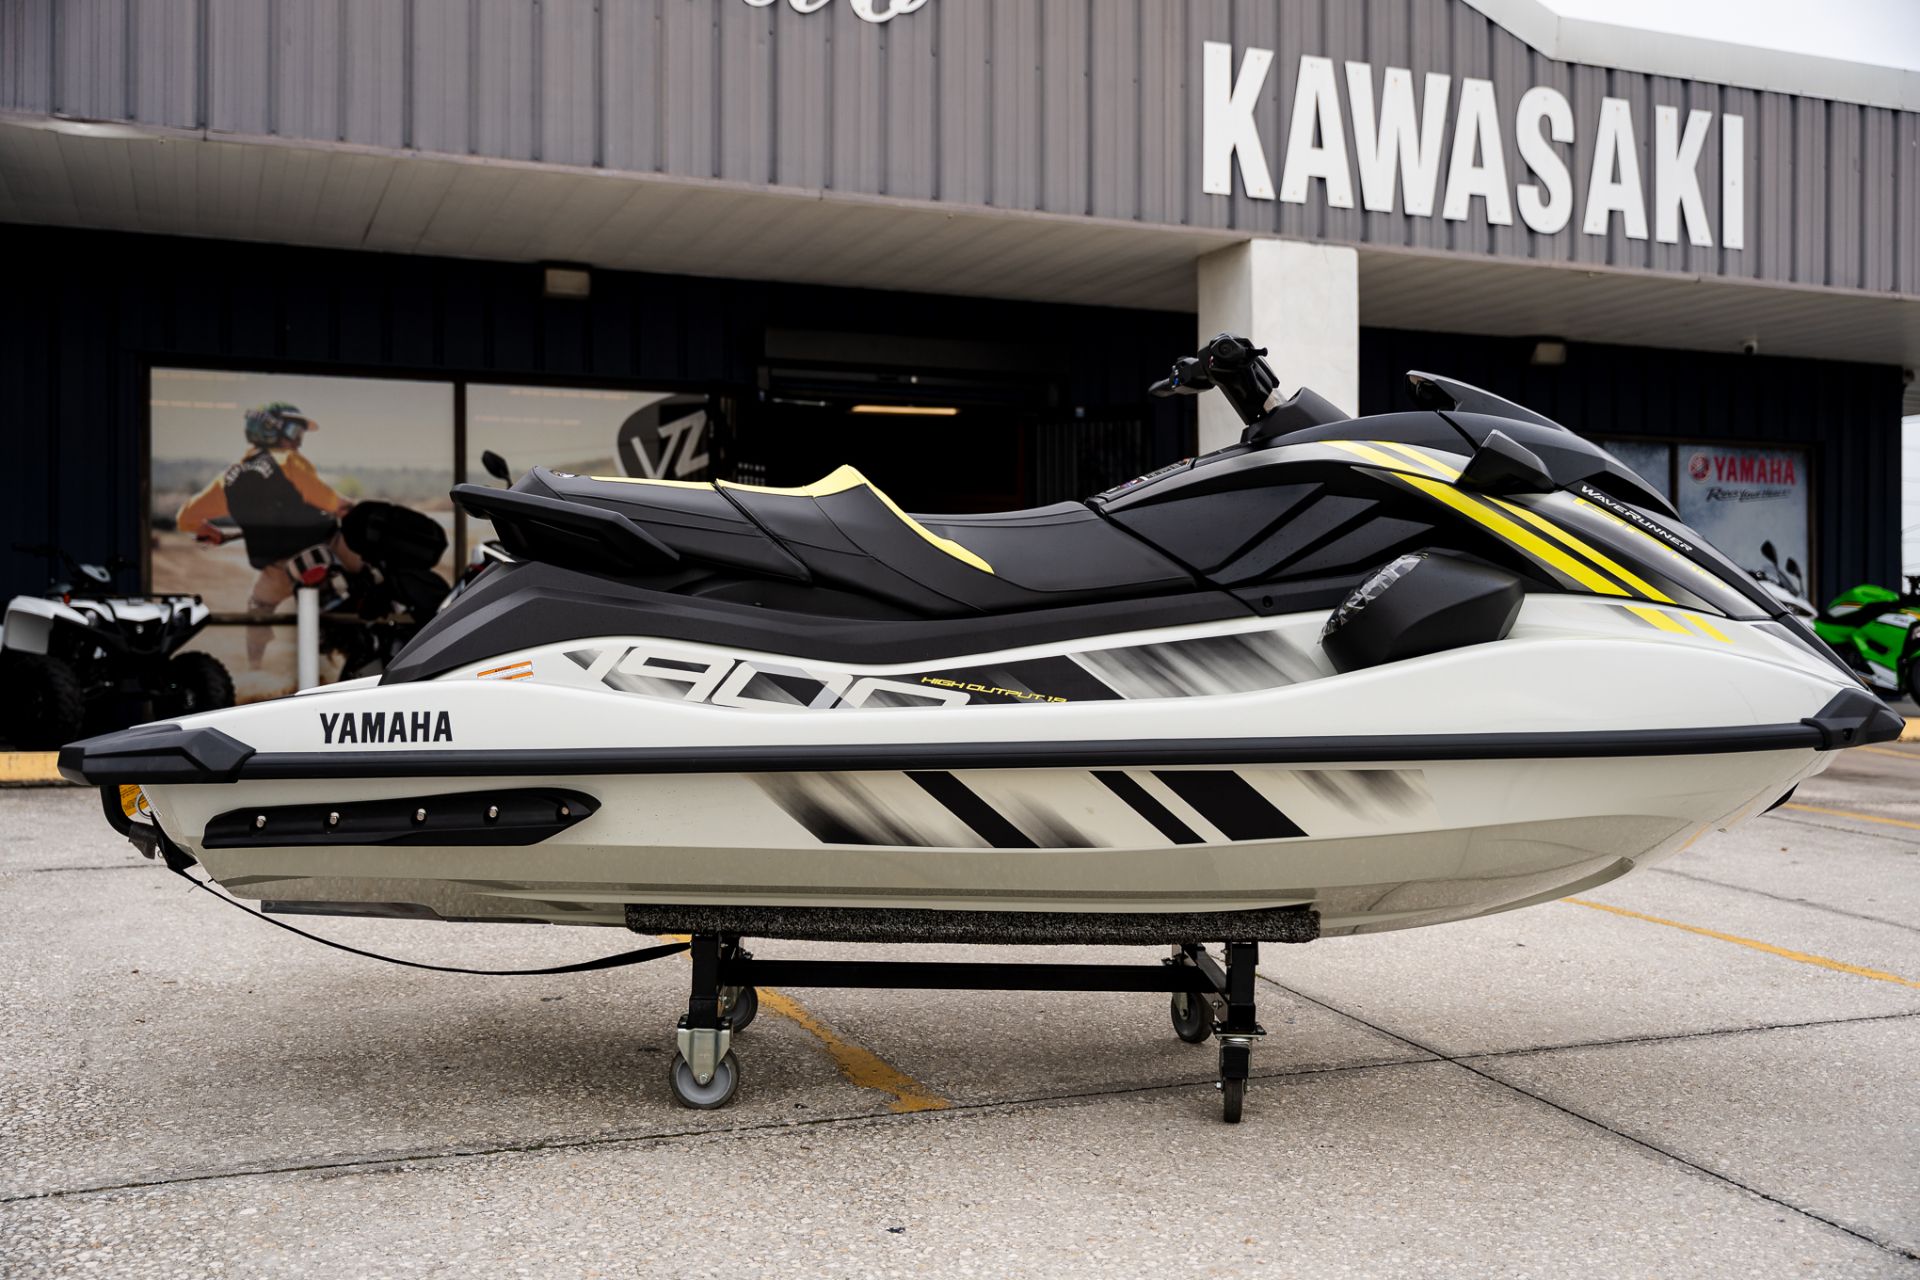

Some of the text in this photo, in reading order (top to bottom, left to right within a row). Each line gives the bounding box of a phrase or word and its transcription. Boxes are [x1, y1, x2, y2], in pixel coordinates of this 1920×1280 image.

[1203, 40, 1744, 250] KAWASAKI
[1713, 455, 1796, 485] YAMAHA
[920, 676, 965, 690] HIGH
[966, 683, 1046, 700] OUTPUT
[319, 710, 454, 744] YAMAHA
